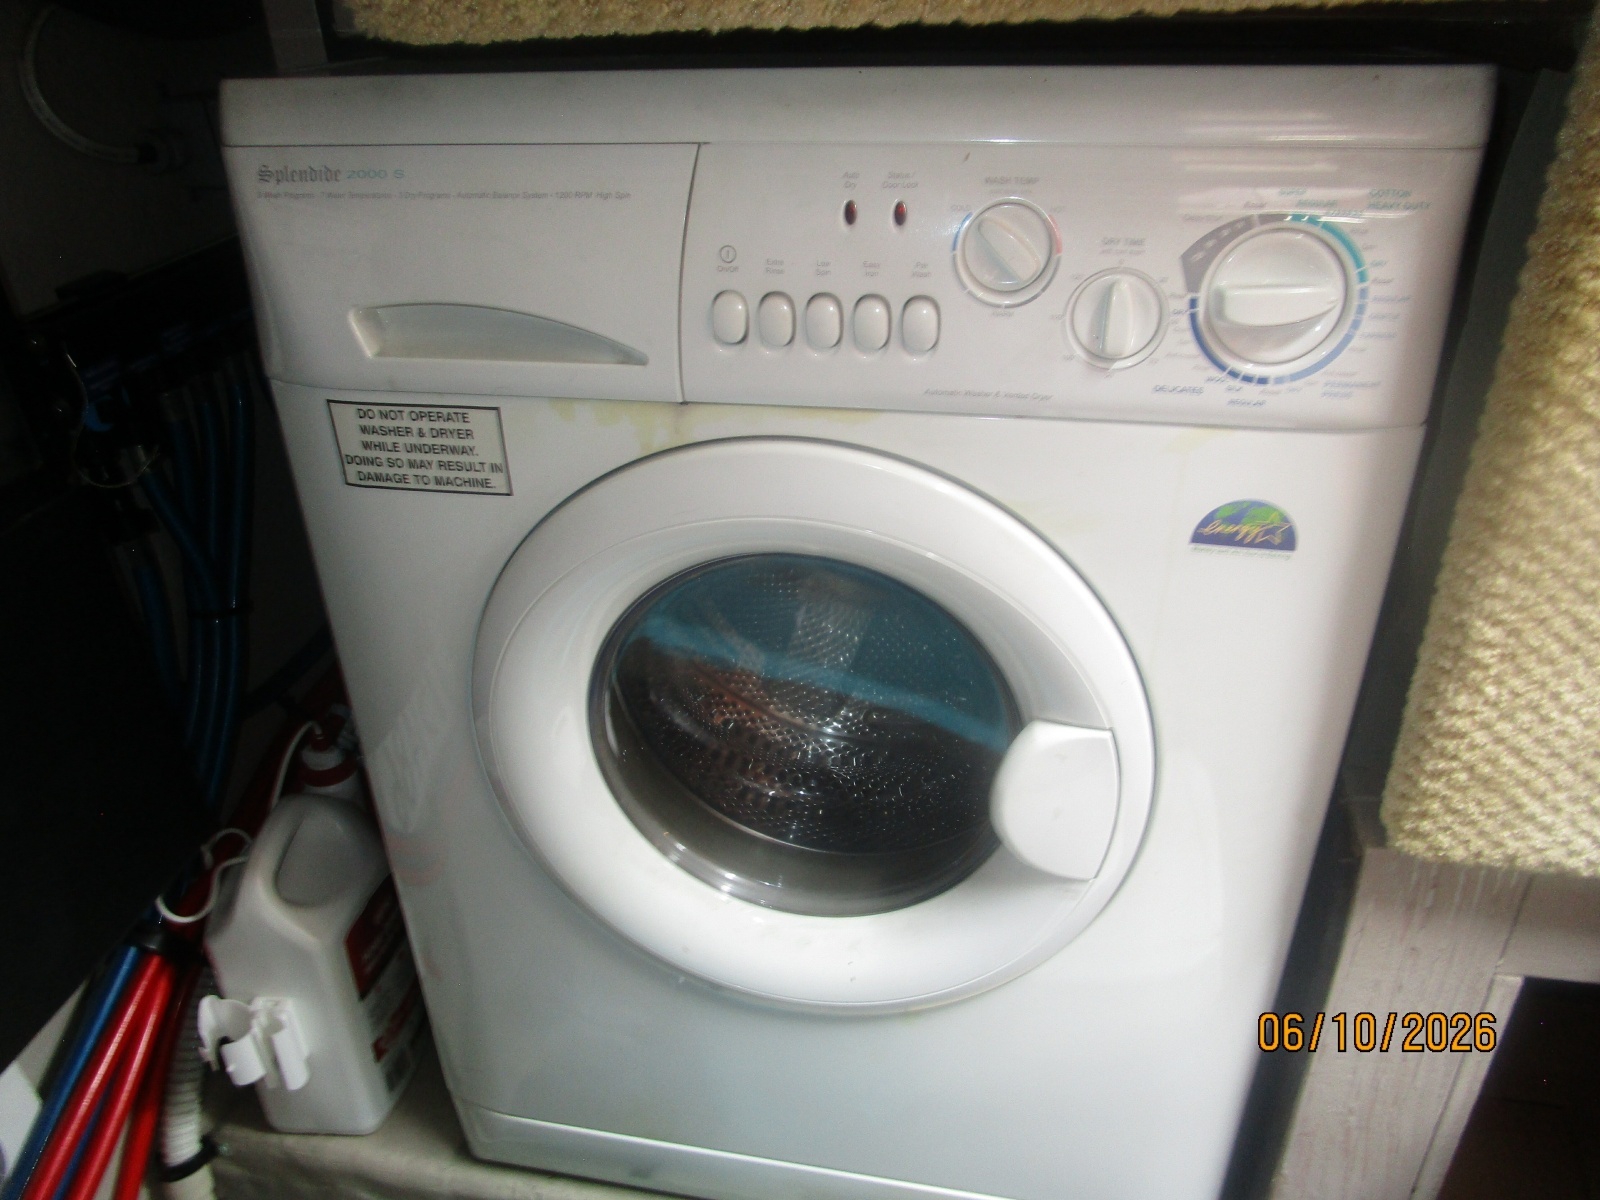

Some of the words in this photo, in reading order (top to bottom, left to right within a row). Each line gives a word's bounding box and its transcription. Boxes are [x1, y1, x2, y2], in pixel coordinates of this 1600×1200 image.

[258, 164, 342, 185] Splendide
[346, 169, 388, 179] 2000
[393, 169, 405, 179] S
[984, 176, 1012, 185] WASH
[1014, 176, 1040, 185] TEMP
[457, 191, 491, 199] Automatic
[522, 191, 548, 199] System
[575, 191, 593, 199] RPM
[596, 191, 613, 200] High
[615, 191, 631, 200] Spin
[357, 408, 376, 420] DO
[379, 409, 405, 421] NOT
[410, 410, 471, 423] OPERATE
[360, 424, 414, 438] WASHER
[418, 427, 427, 438] &
[430, 428, 475, 440] DRYER
[362, 440, 400, 453] WHILE
[404, 442, 479, 457] UNDERWAY.
[344, 454, 384, 467] DOING
[387, 457, 405, 469] SO
[408, 459, 434, 470] MAY
[438, 460, 486, 473] RESULT
[491, 462, 504, 474] IN
[358, 471, 411, 485] DAMAGE
[413, 474, 431, 487] TO
[435, 475, 497, 489] MACHINE.
